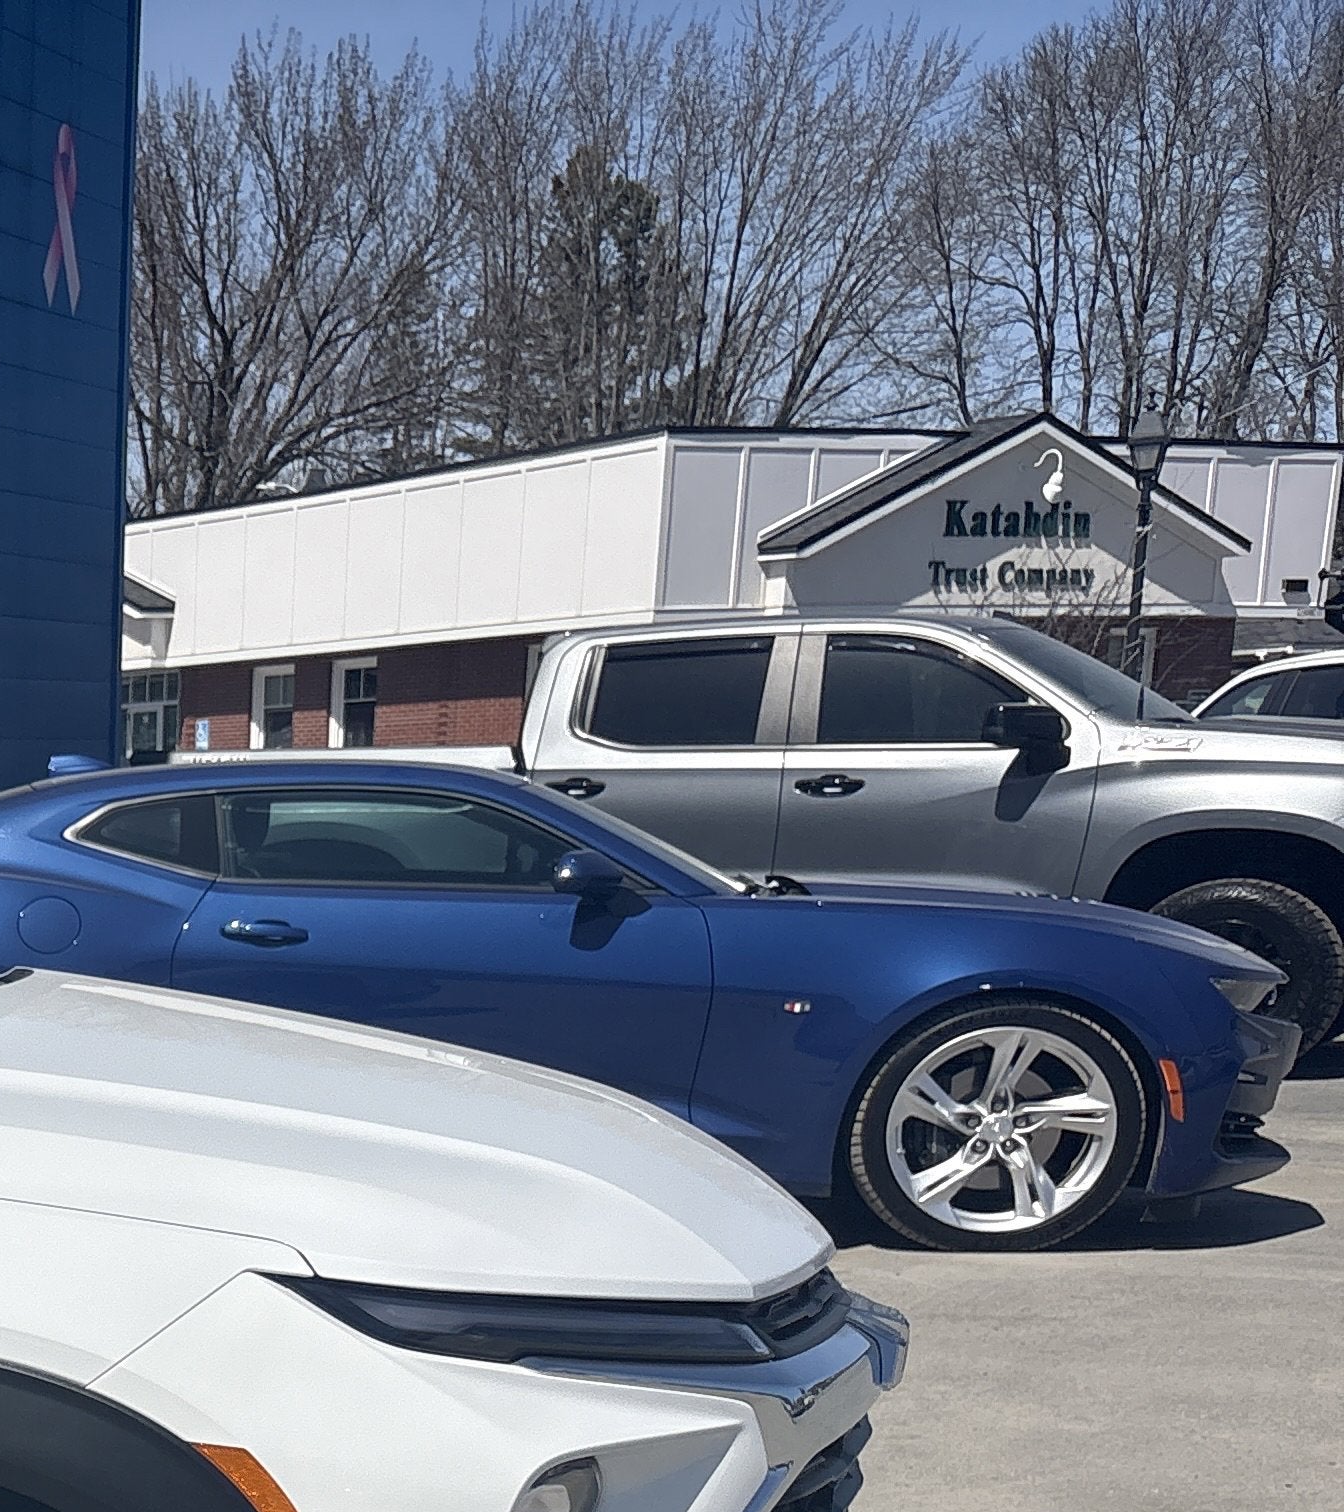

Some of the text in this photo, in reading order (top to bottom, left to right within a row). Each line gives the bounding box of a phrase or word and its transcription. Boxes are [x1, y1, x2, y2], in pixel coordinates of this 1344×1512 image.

[943, 501, 1090, 537] Katahdin
[928, 561, 1095, 598] Trust Company
